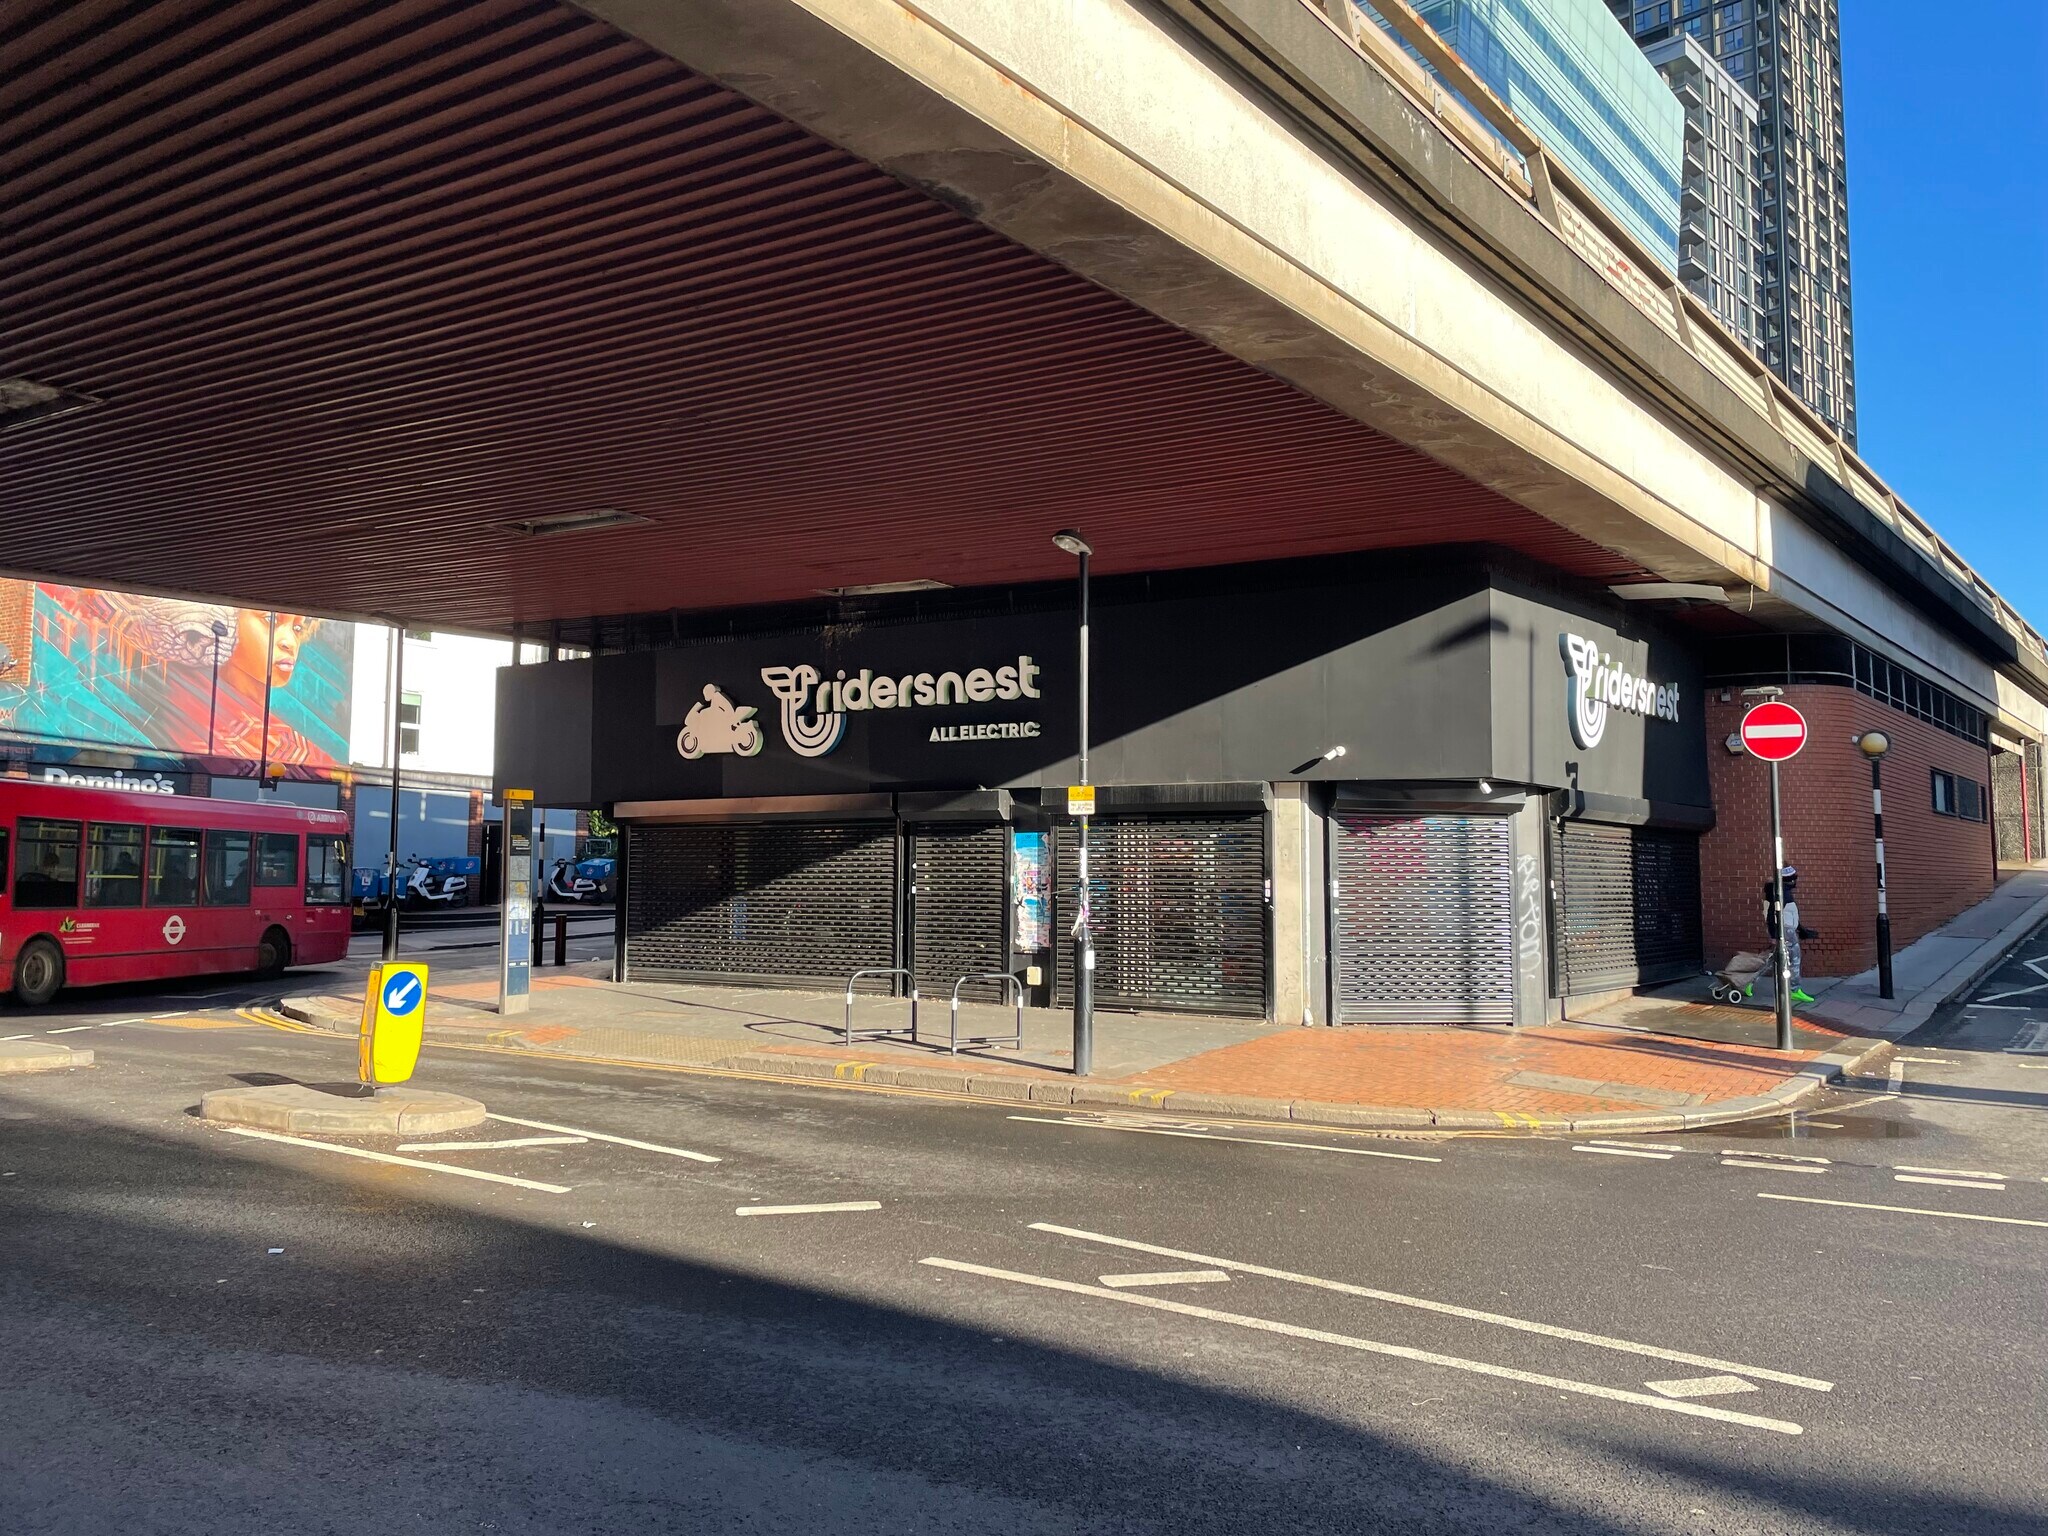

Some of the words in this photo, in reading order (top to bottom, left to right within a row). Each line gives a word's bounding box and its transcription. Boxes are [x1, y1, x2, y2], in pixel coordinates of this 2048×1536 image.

[816, 655, 1041, 713] ridersnest
[1595, 652, 1680, 723] ridersnest
[44, 767, 175, 795] Domino's
